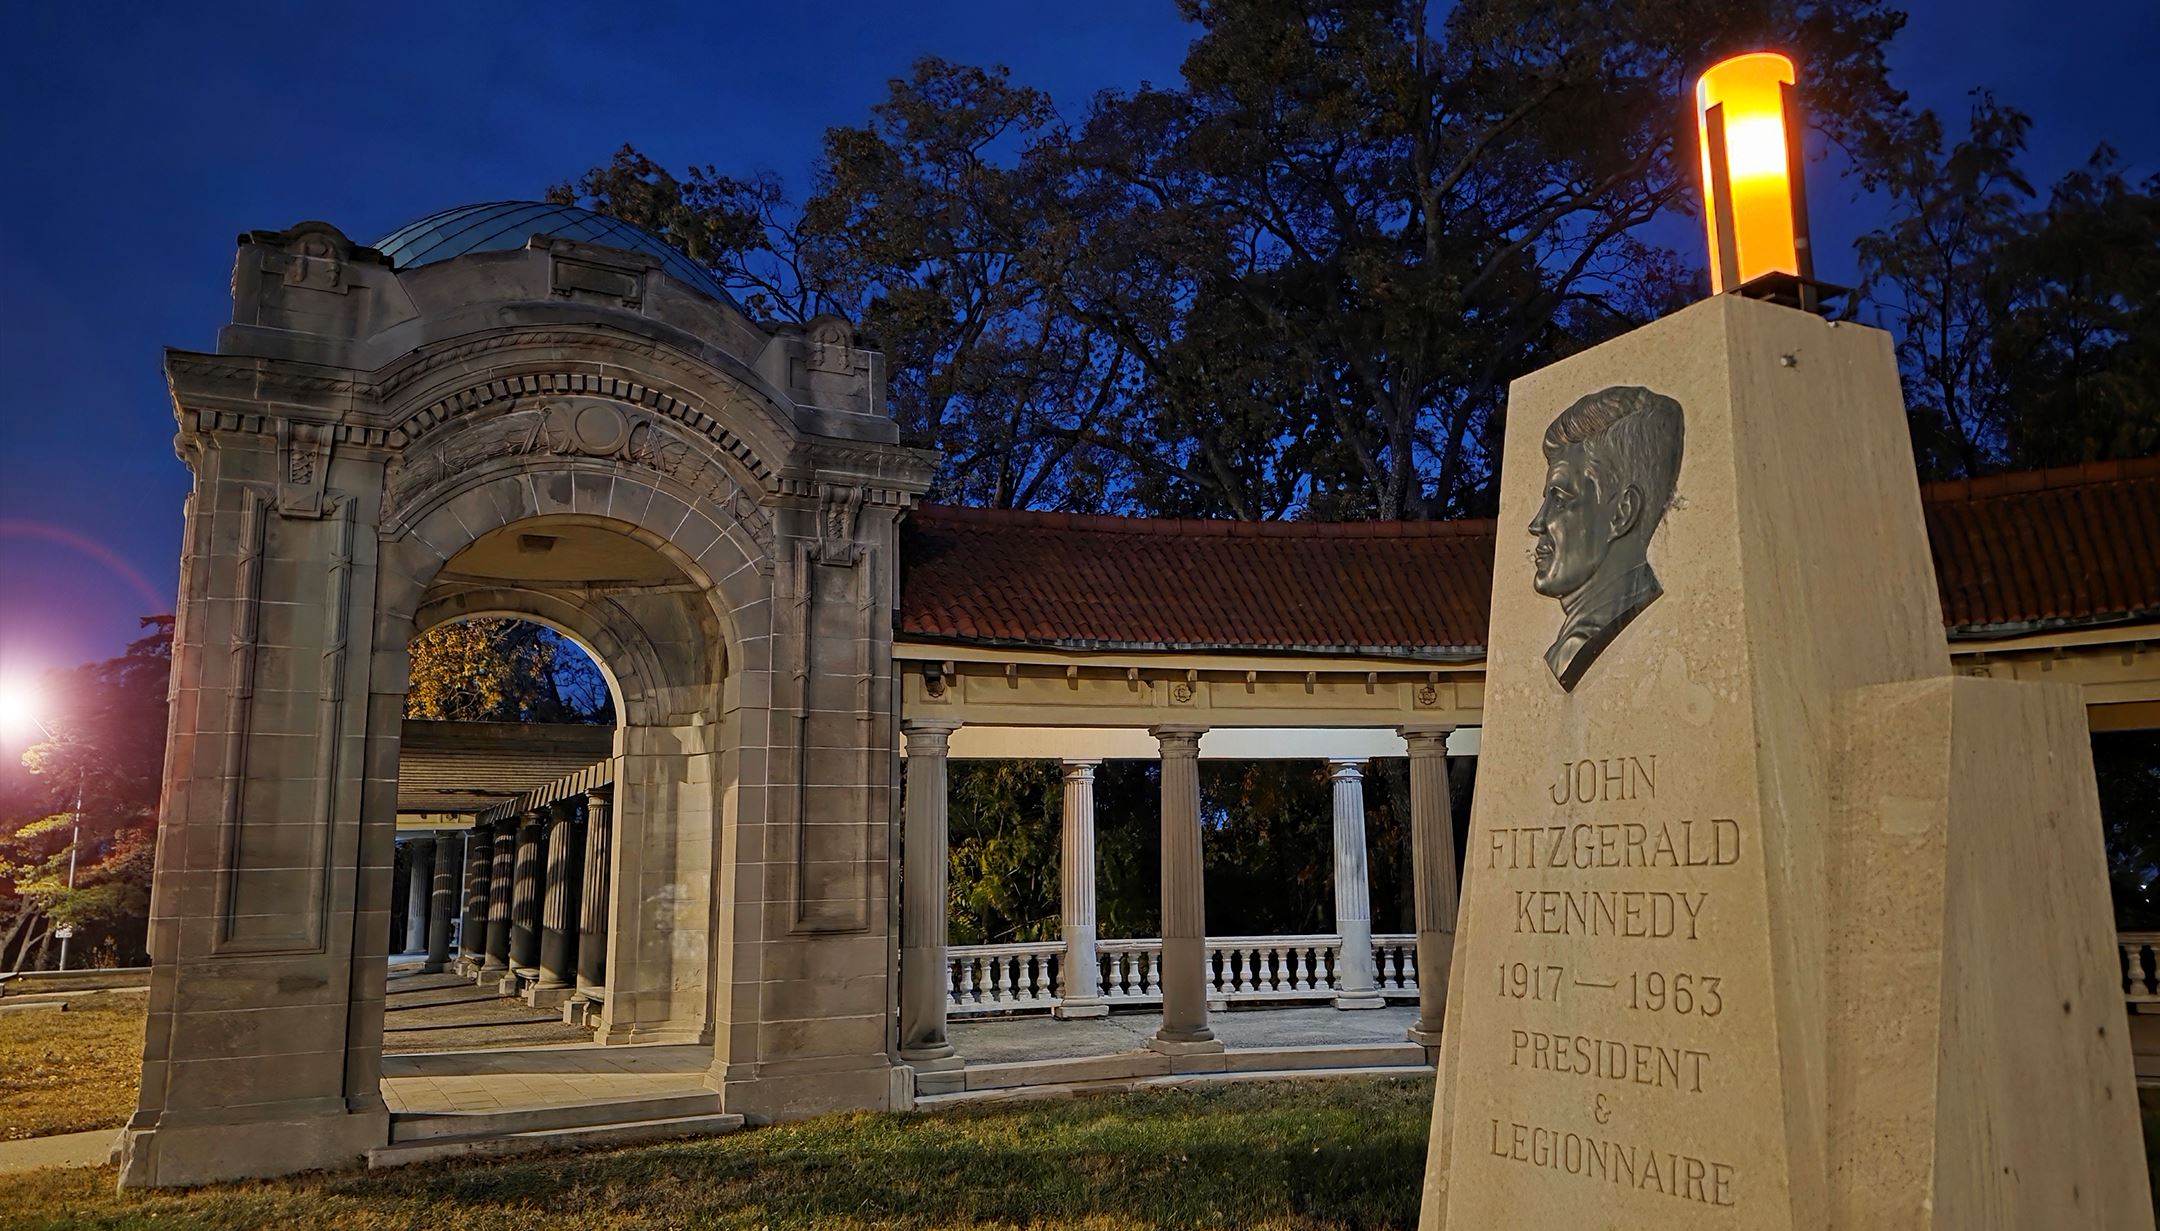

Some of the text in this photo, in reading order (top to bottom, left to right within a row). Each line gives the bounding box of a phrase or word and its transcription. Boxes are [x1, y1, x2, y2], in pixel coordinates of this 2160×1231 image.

[1549, 754, 1658, 806] JOHN
[1487, 818, 1741, 870] FITZGERALD
[1513, 890, 1709, 941] KENNEDY
[1510, 1029, 1711, 1094] PRESIDENT
[1594, 1093, 1613, 1125] &
[1489, 1119, 1736, 1207] LEGIONNAIRE
